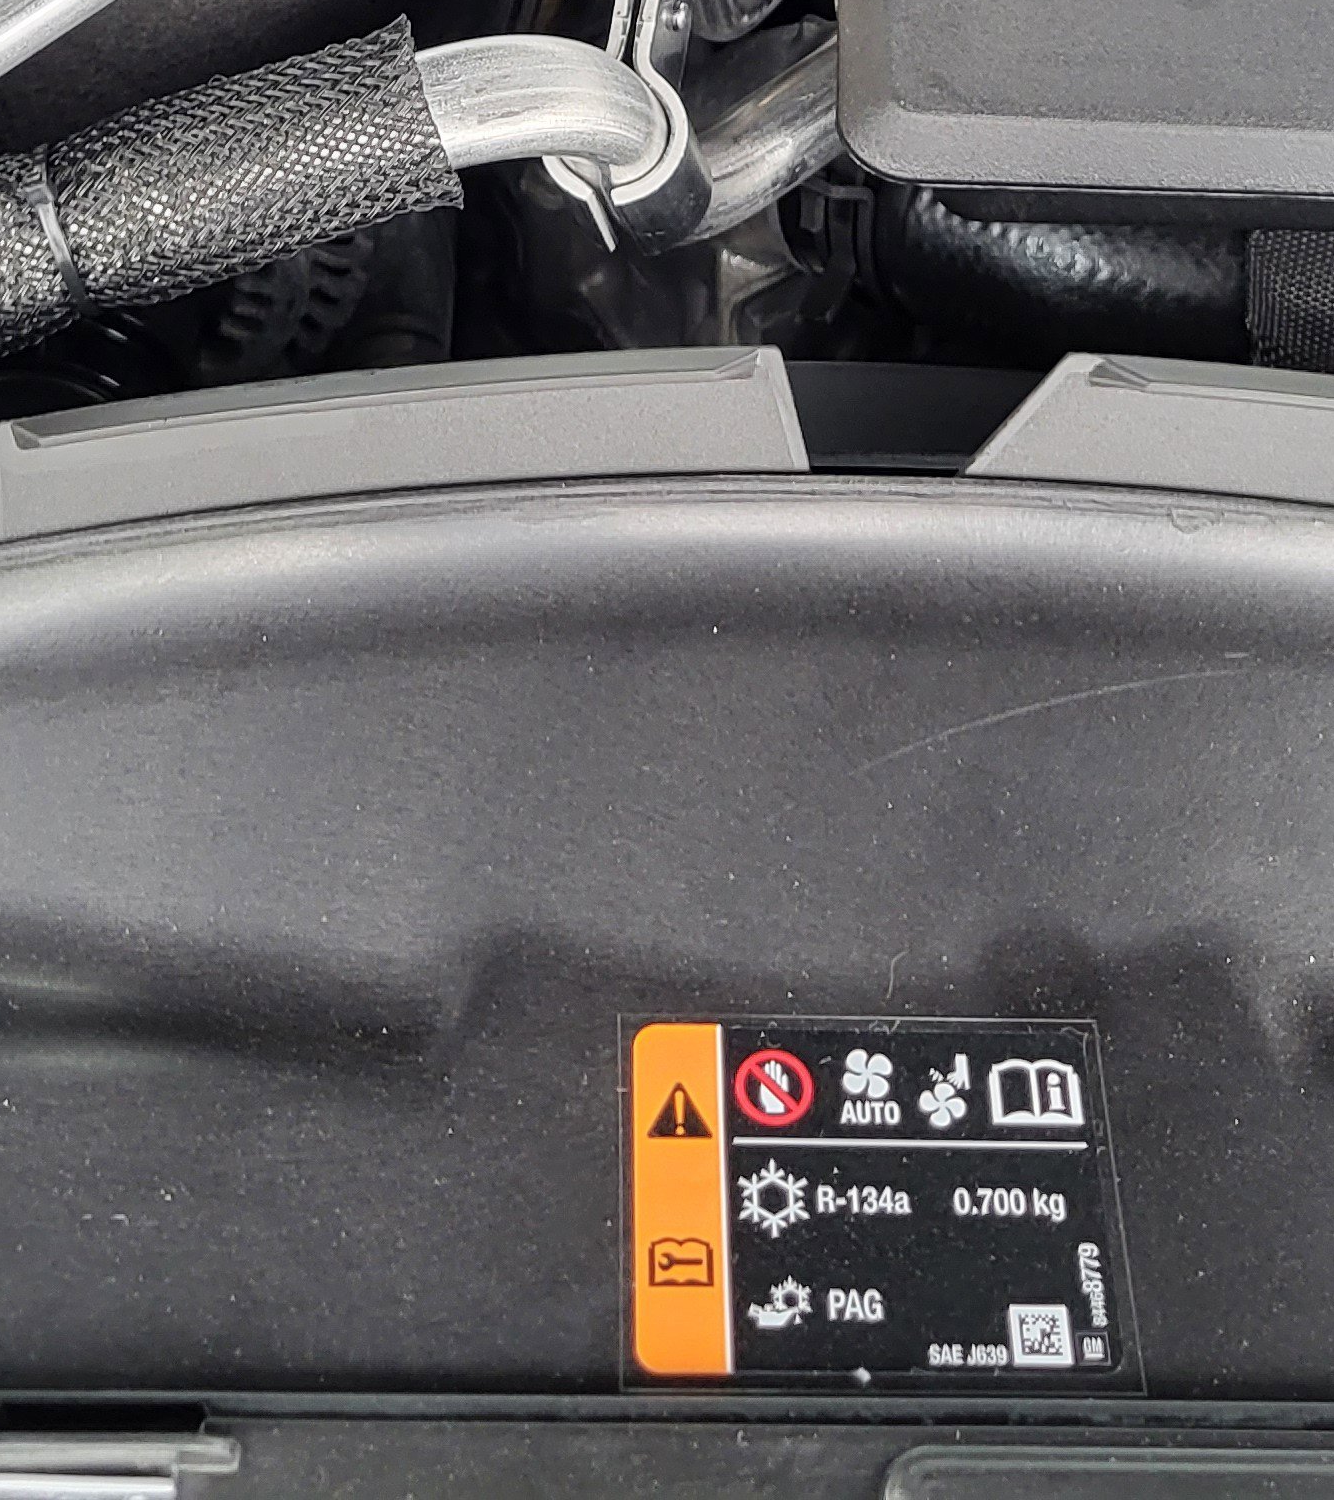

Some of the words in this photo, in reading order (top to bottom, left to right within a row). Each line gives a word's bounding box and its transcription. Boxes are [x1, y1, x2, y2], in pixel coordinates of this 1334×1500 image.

[841, 1100, 901, 1126] AUTO
[817, 1186, 911, 1215] R-134a
[954, 1187, 1025, 1216] 0.700
[1031, 1187, 1066, 1222] kg
[1078, 1242, 1108, 1328] 84468779
[828, 1289, 883, 1322] PAG
[929, 1344, 963, 1365] SAE
[967, 1344, 1007, 1366] J639
[1082, 1336, 1106, 1356] GM
